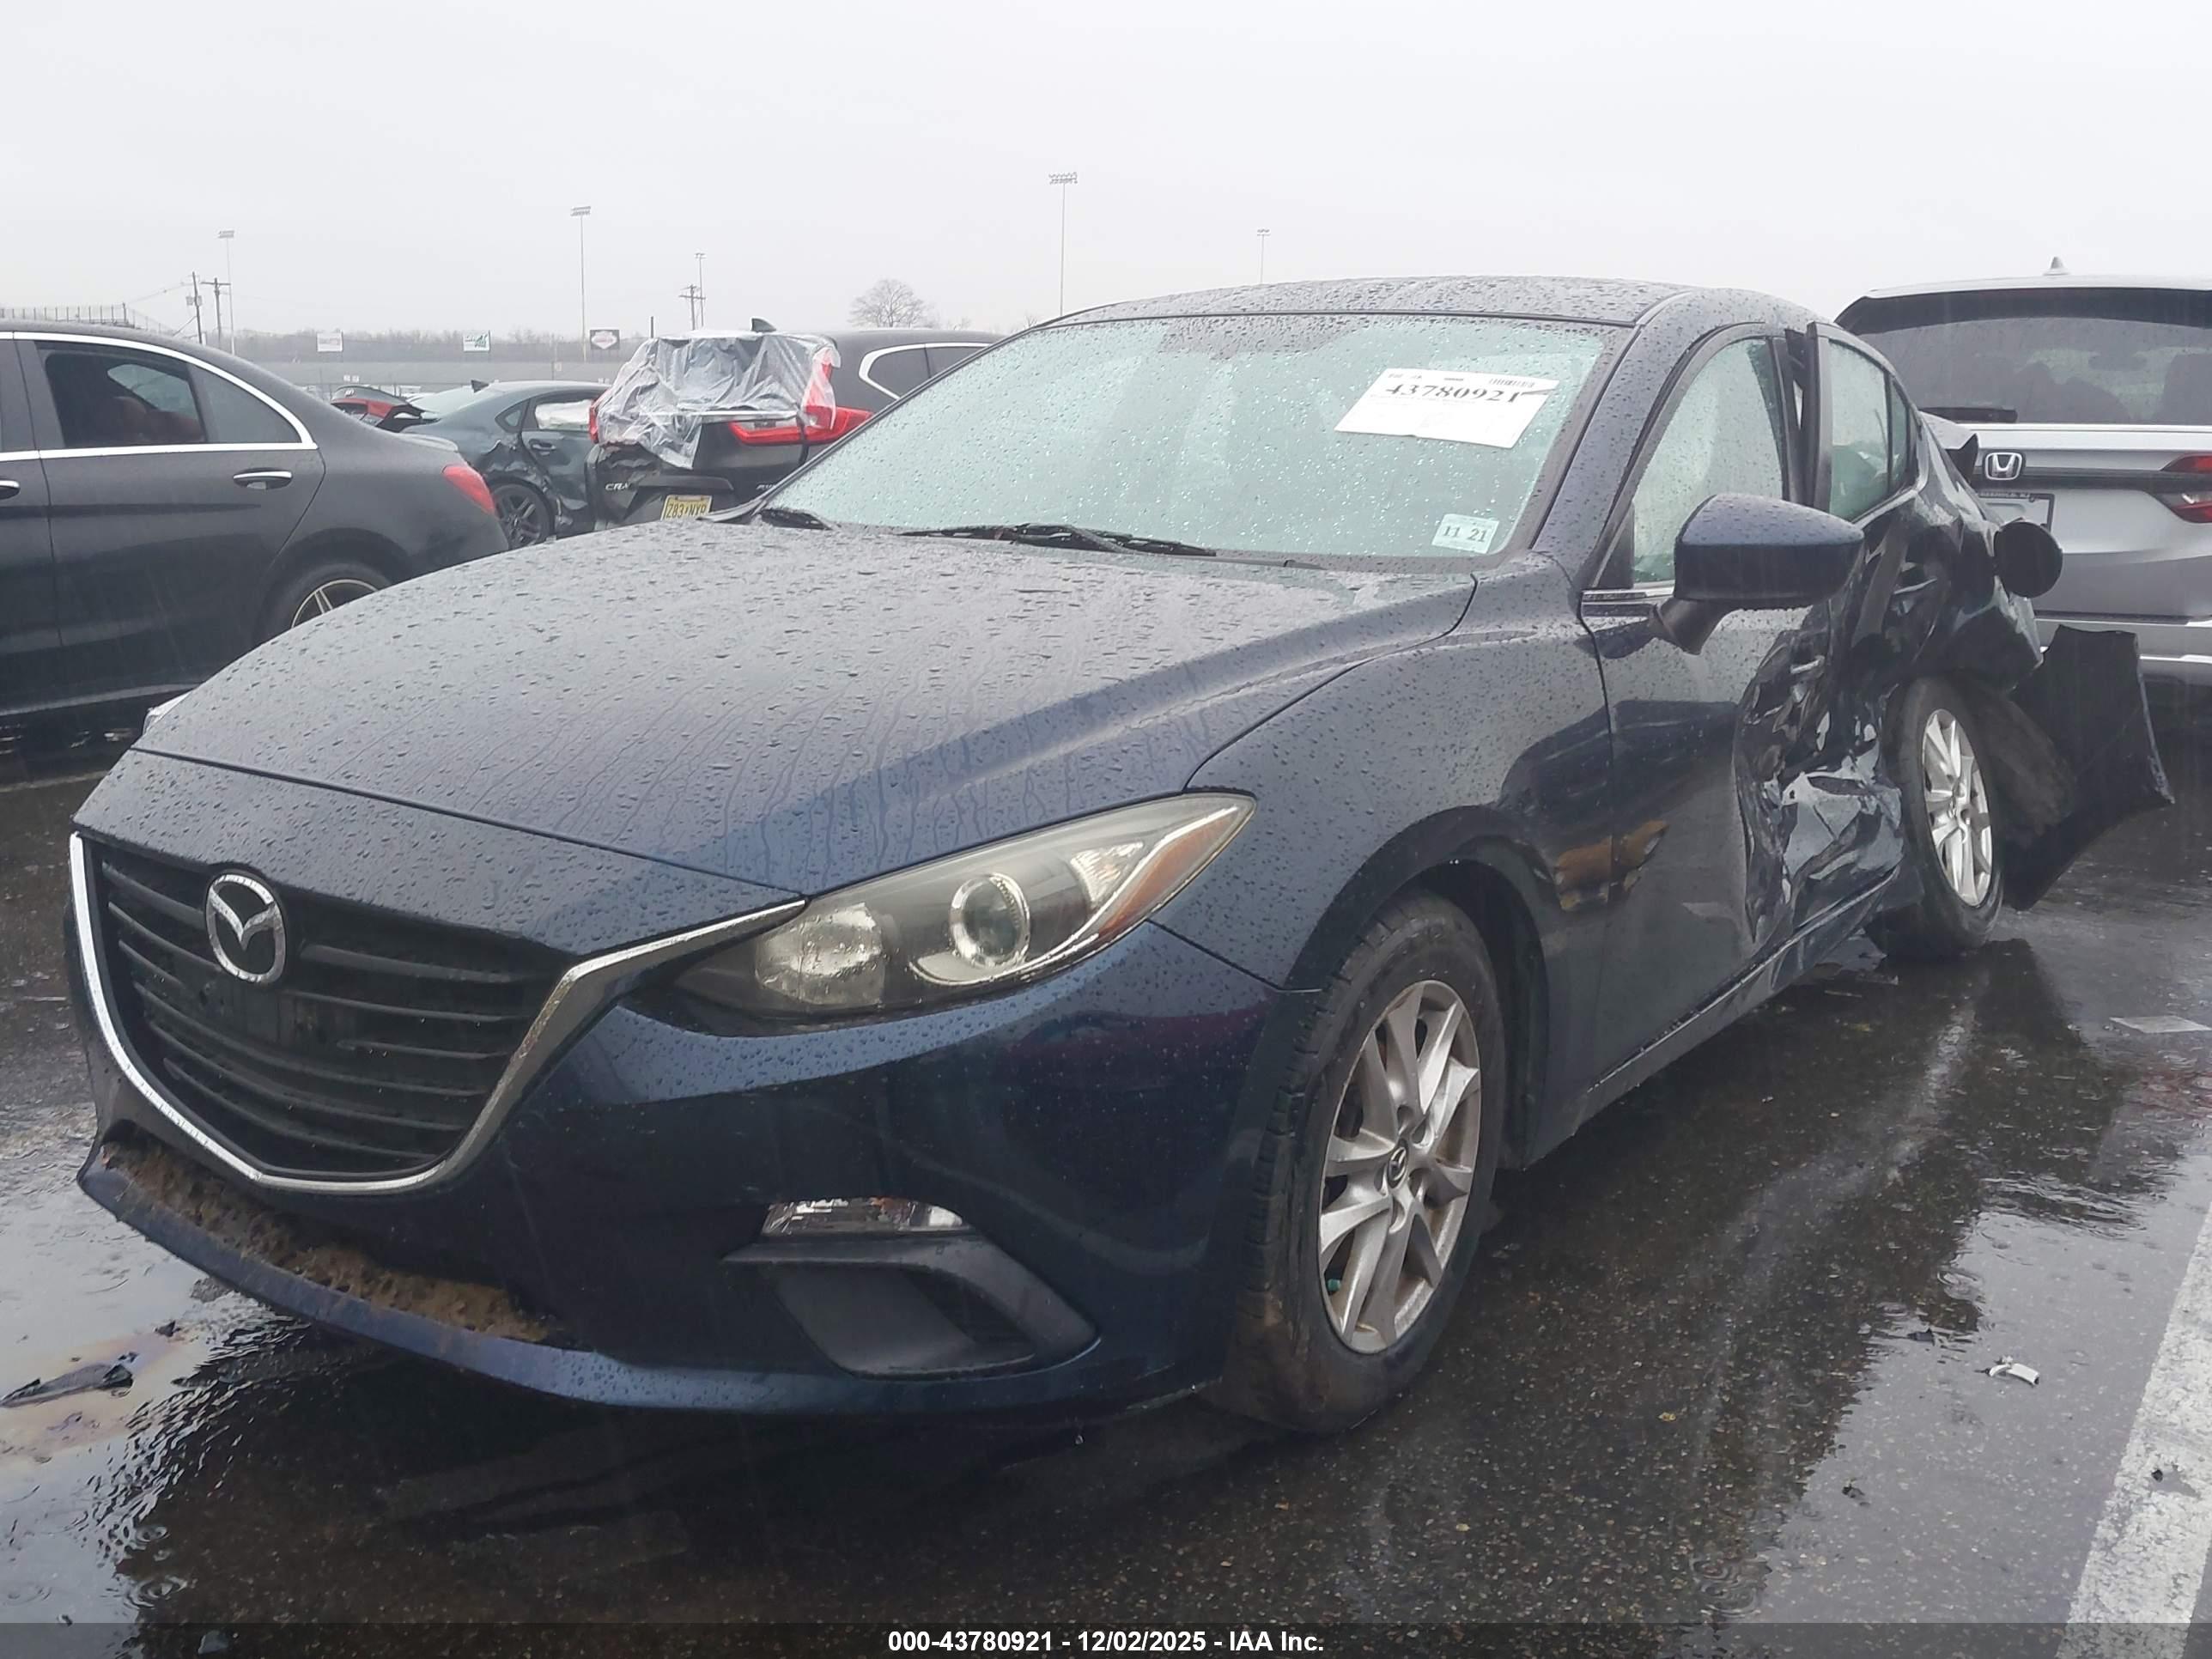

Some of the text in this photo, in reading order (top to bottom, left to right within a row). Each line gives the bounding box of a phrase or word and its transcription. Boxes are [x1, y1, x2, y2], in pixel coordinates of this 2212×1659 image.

[1385, 384, 1520, 403] 43780921
[1443, 526, 1487, 543] 11 21
